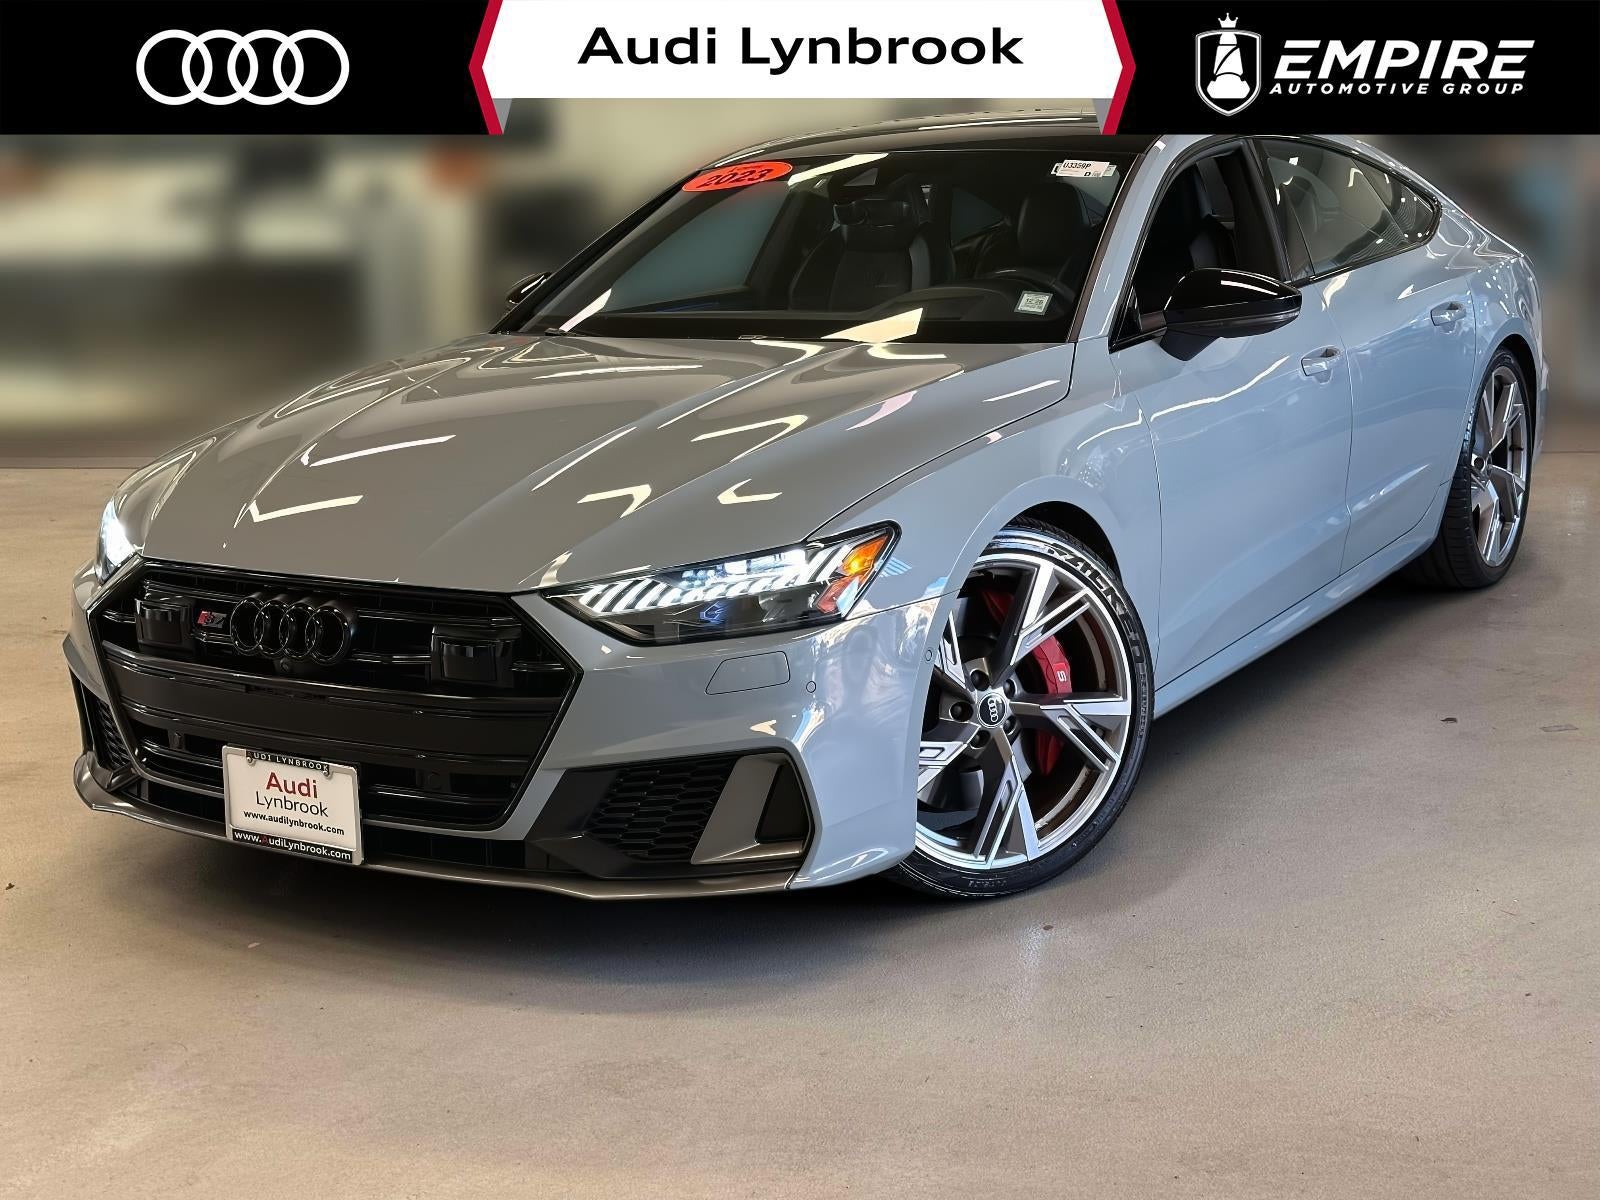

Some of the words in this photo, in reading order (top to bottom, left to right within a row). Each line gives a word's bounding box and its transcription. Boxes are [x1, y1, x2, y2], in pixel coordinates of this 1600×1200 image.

[696, 168, 774, 188] 2023
[276, 756, 328, 771] LYNBROOK
[266, 771, 318, 798] Audi
[256, 791, 329, 818] Lynbrook
[243, 810, 345, 836] www.audilynbrook.com
[234, 831, 351, 860] www.AudiLynbrook.com
